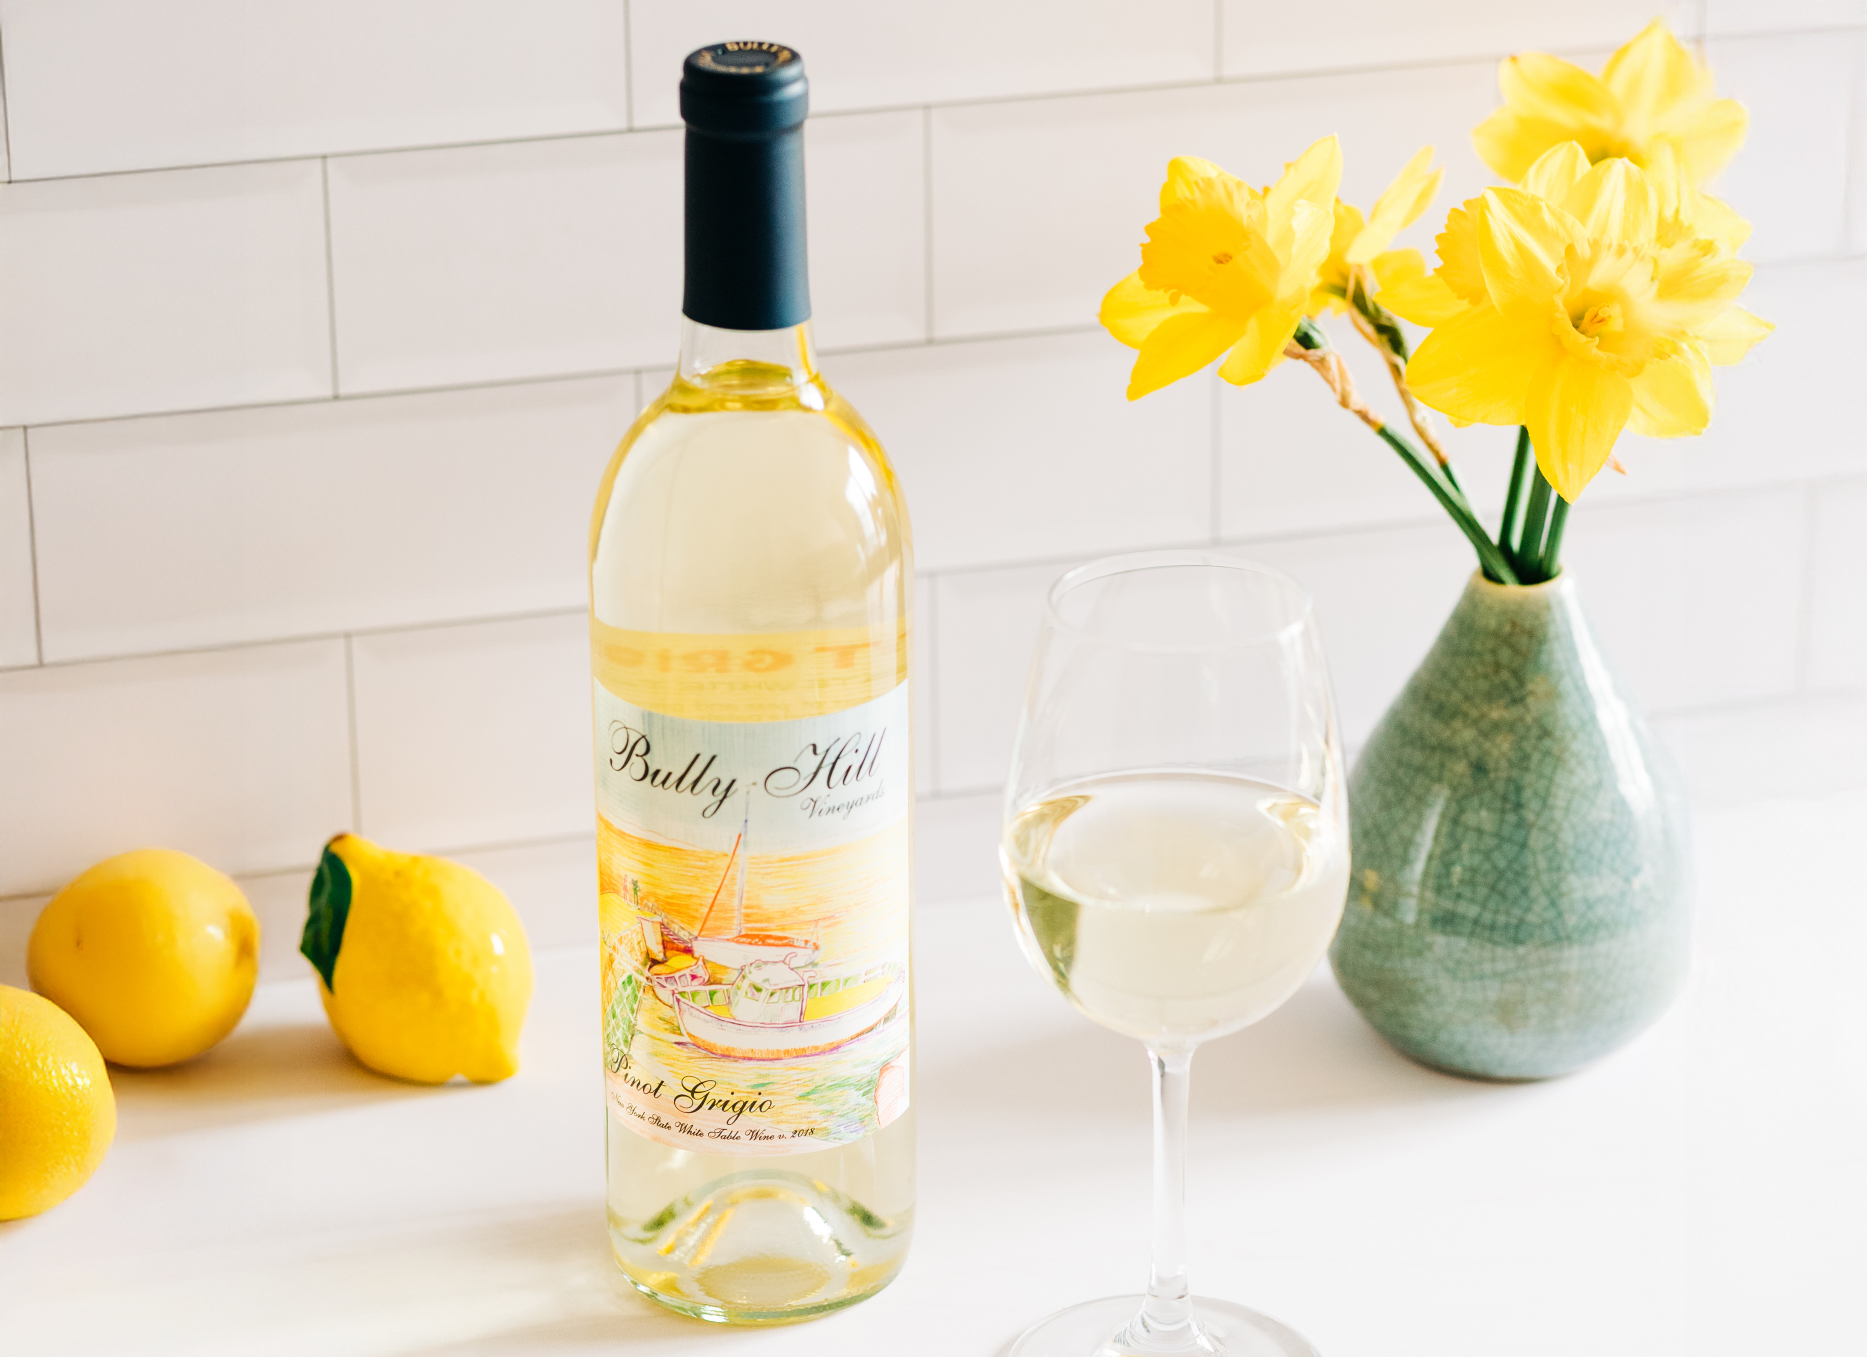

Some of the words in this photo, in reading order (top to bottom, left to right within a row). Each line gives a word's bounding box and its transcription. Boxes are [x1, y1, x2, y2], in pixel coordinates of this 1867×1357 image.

[608, 720, 738, 818] Bully
[764, 727, 887, 797] Hill
[800, 779, 885, 820] Vineyards
[610, 1043, 666, 1099] Pinot
[673, 1075, 775, 1125] Grigio
[625, 1102, 646, 1122] York
[647, 1112, 672, 1131] State
[674, 1121, 705, 1138] White
[707, 1127, 741, 1141] Table
[744, 1128, 775, 1142] Wine
[790, 1127, 815, 1139] 2018
